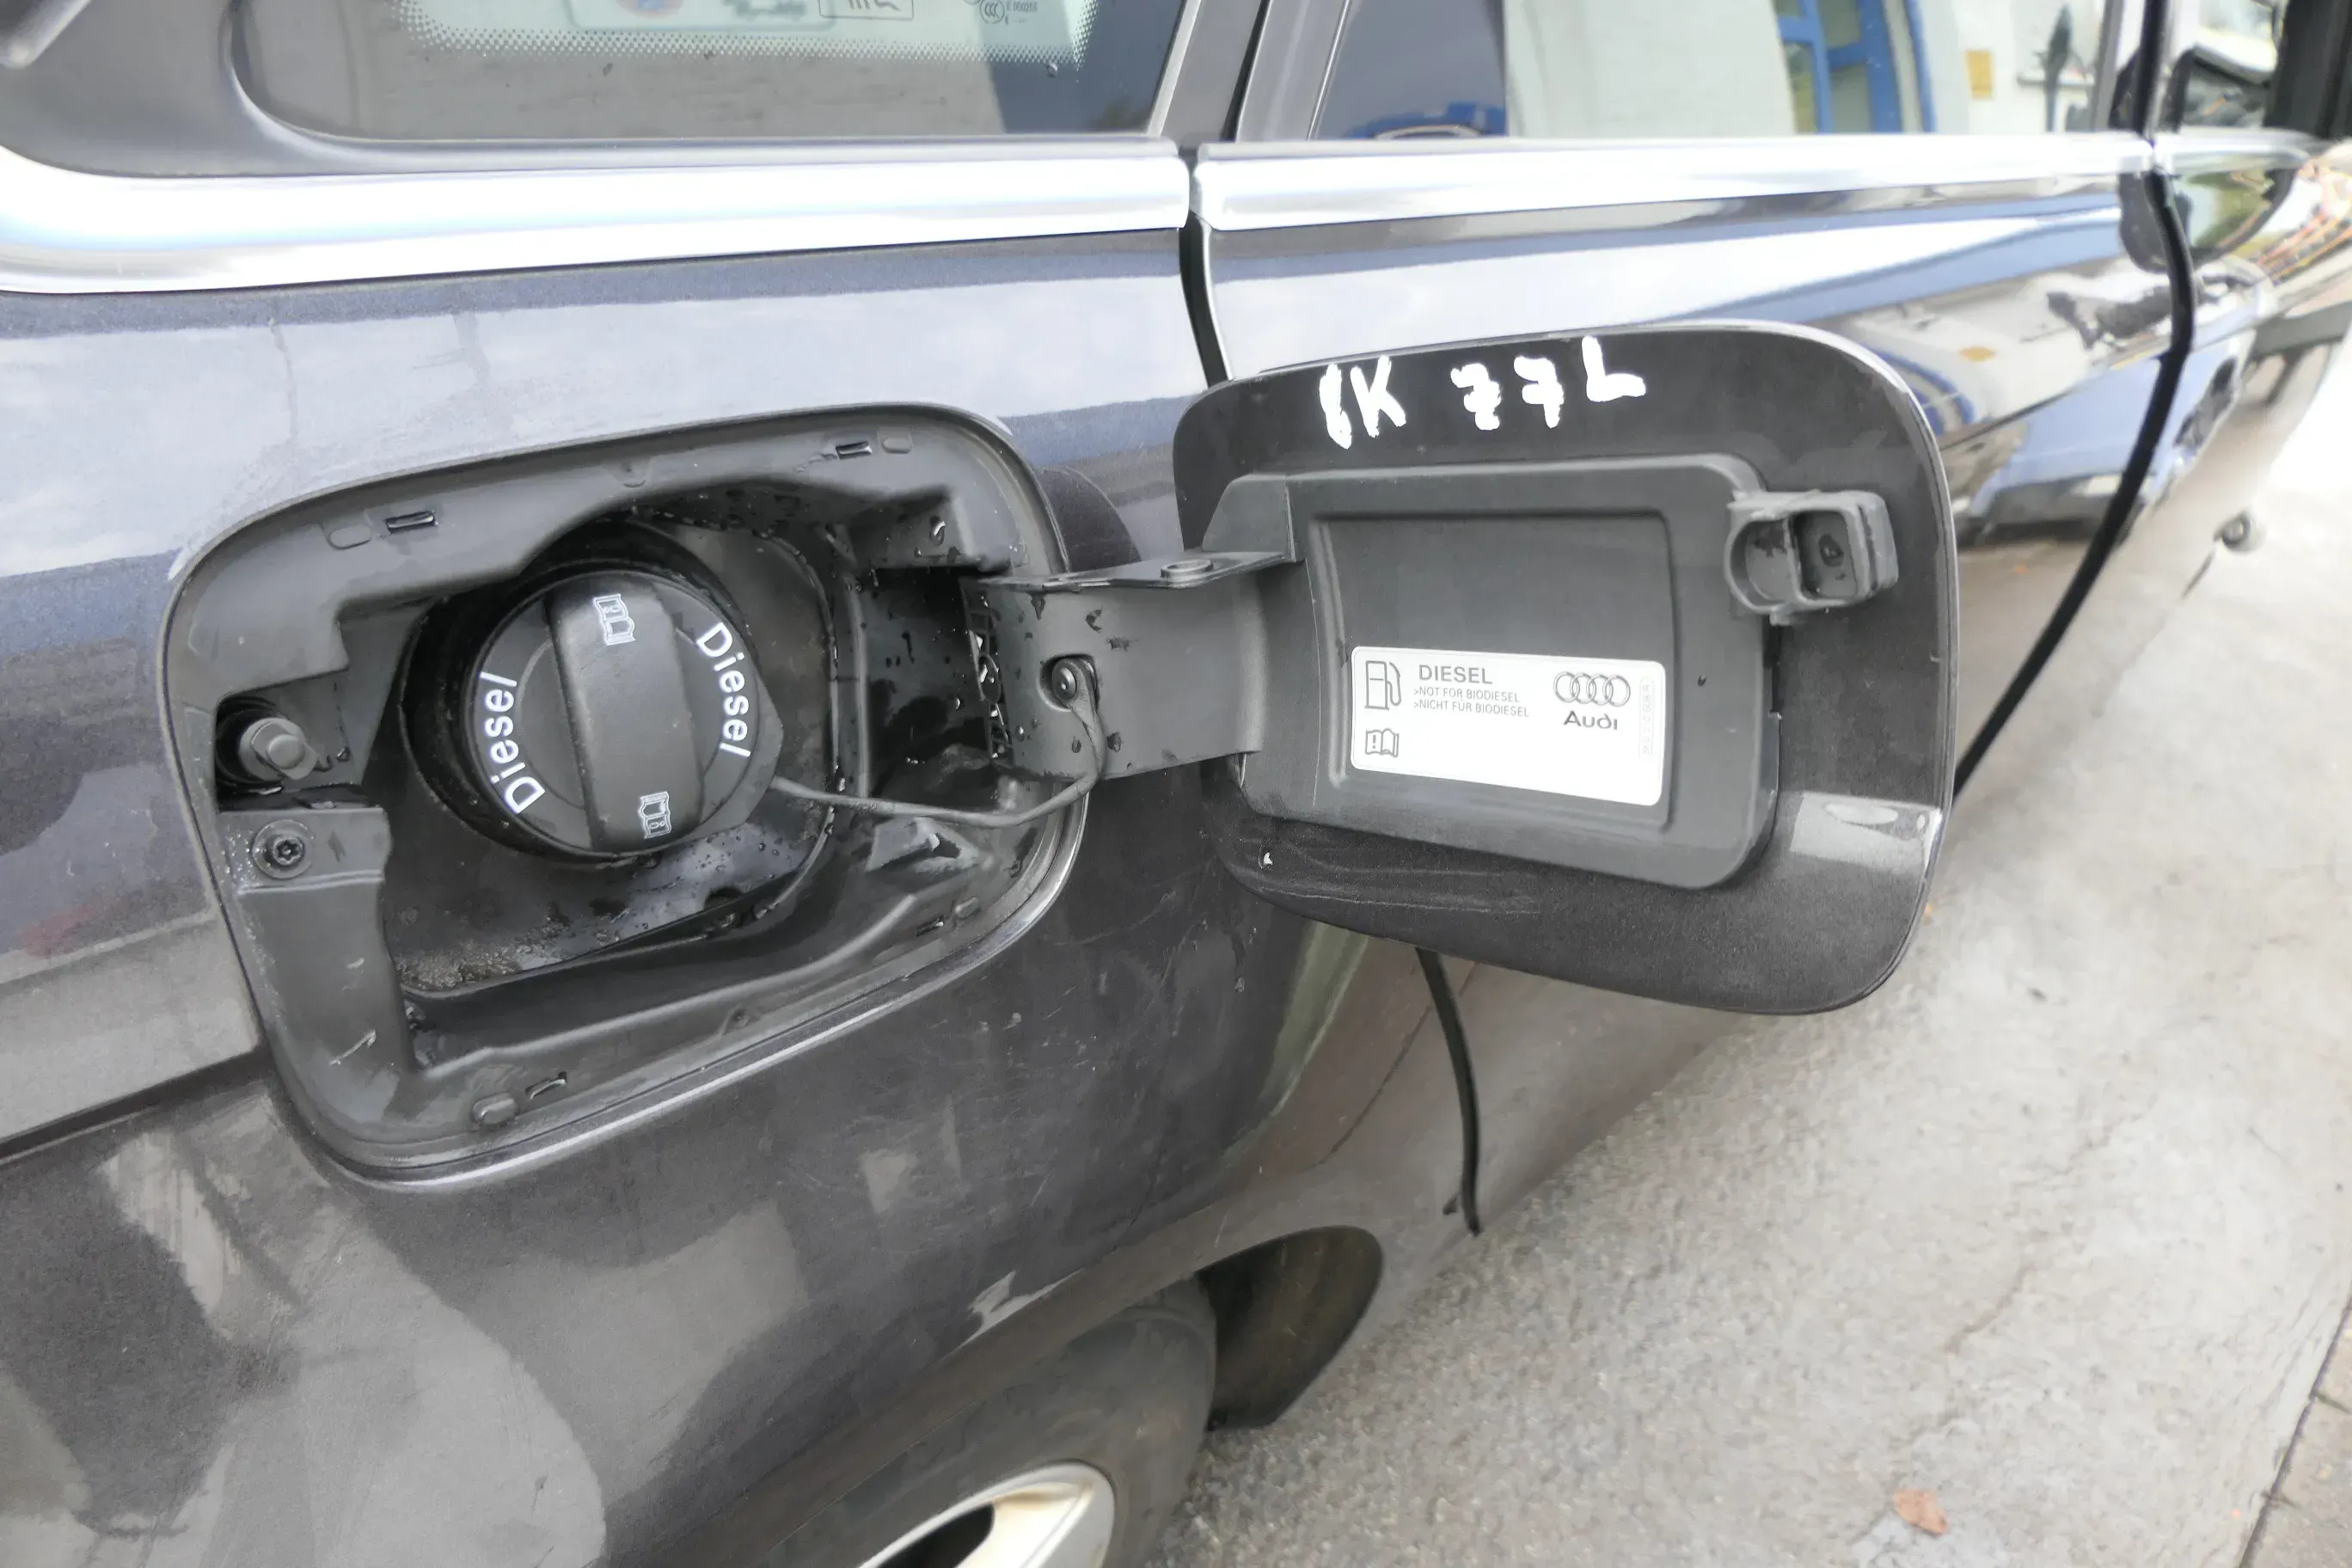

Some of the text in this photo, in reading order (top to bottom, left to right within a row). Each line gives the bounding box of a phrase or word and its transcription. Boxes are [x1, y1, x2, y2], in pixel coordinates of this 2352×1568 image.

[1418, 665, 1493, 684] DIESEL
[695, 622, 752, 757] Diesel
[1443, 688, 1463, 698] FOR
[1467, 689, 1521, 703] BIODIESEL
[1476, 703, 1529, 718] BIODIESEL
[1563, 710, 1618, 731] Audi
[479, 671, 546, 813] Diesel
